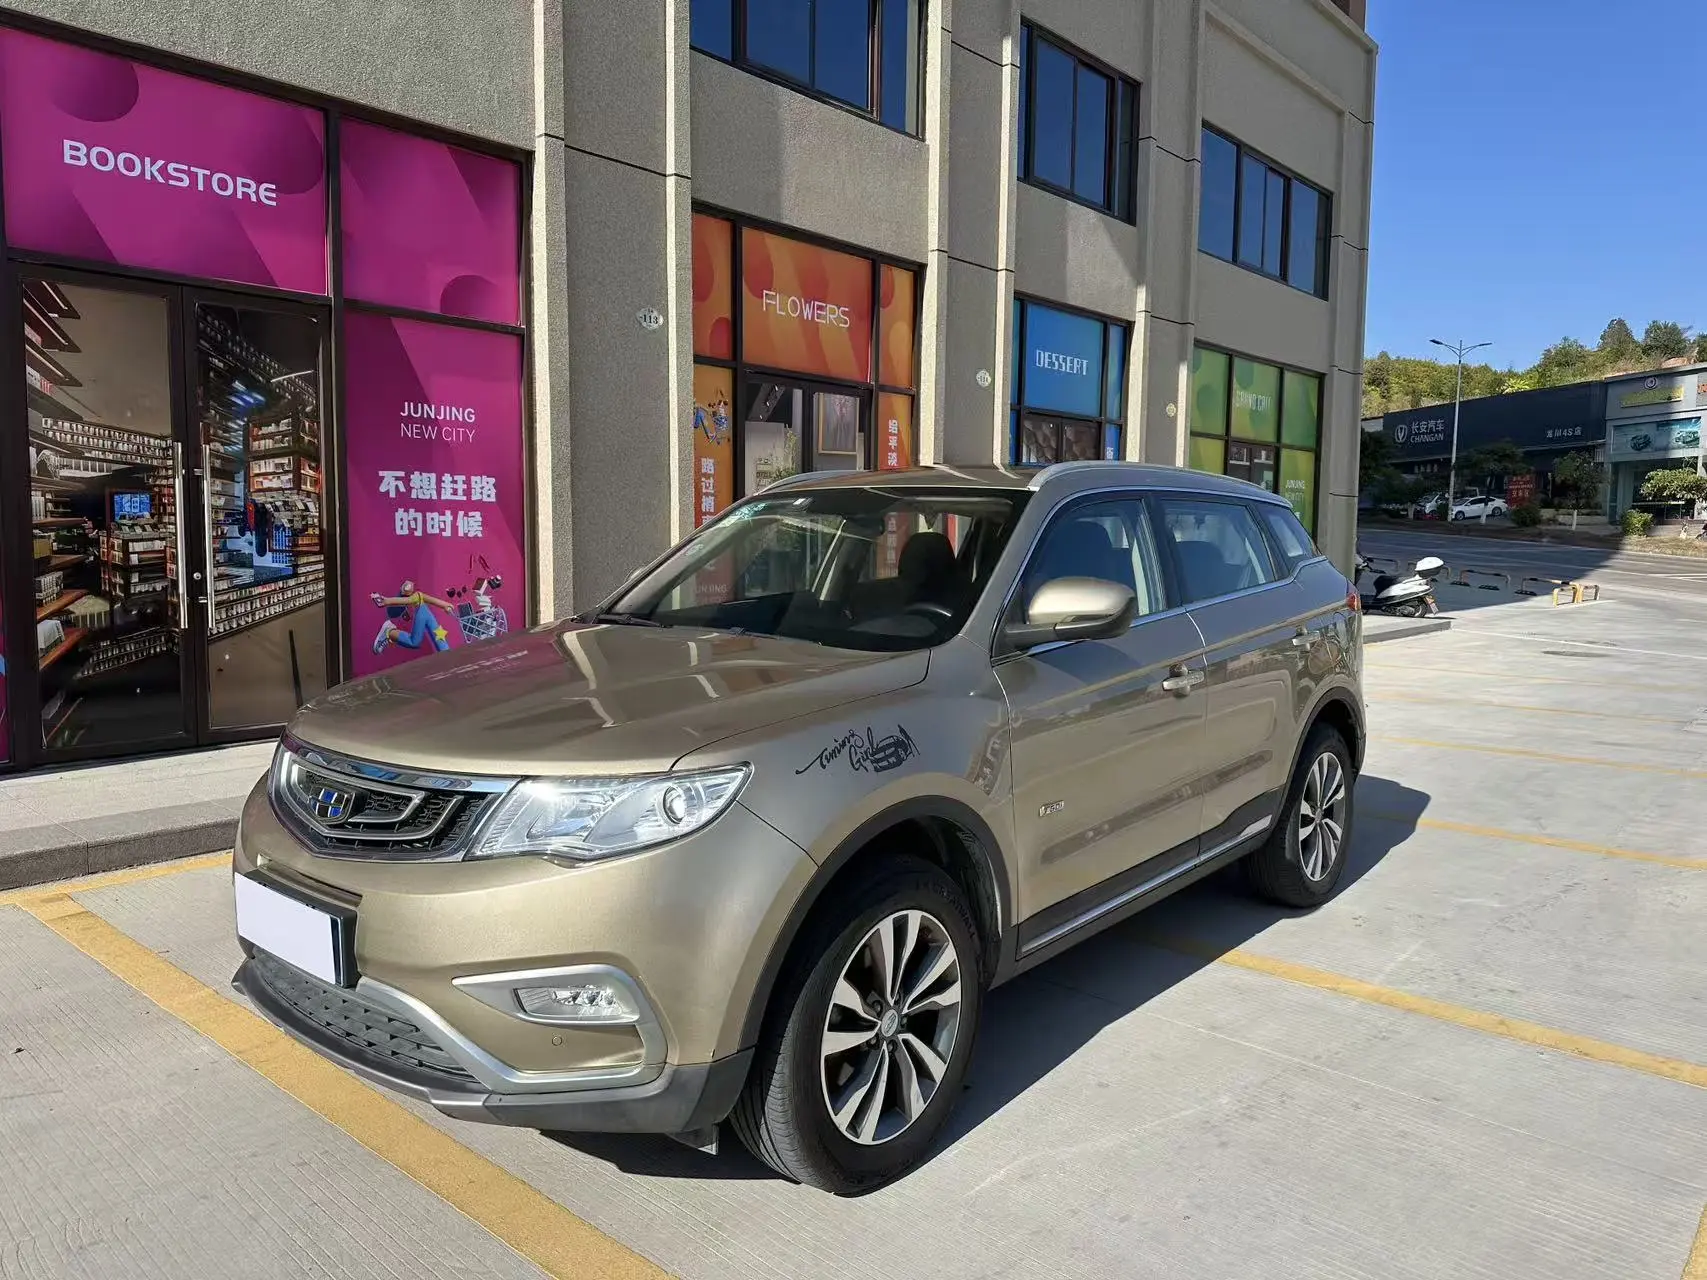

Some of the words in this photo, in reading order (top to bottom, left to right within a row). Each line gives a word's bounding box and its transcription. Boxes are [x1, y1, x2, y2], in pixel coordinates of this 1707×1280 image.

[63, 139, 277, 206] BOOKSTORE
[763, 289, 850, 328] FLOWERS
[1036, 349, 1088, 375] DESSERT
[400, 401, 475, 422] JUNJING
[400, 423, 437, 440] NEW
[442, 426, 475, 443] CITY
[1411, 419, 1444, 434] 长安汽车
[1411, 433, 1444, 443] CHANGAN
[378, 470, 497, 502] 不想赶路
[394, 508, 483, 537] 的时候
